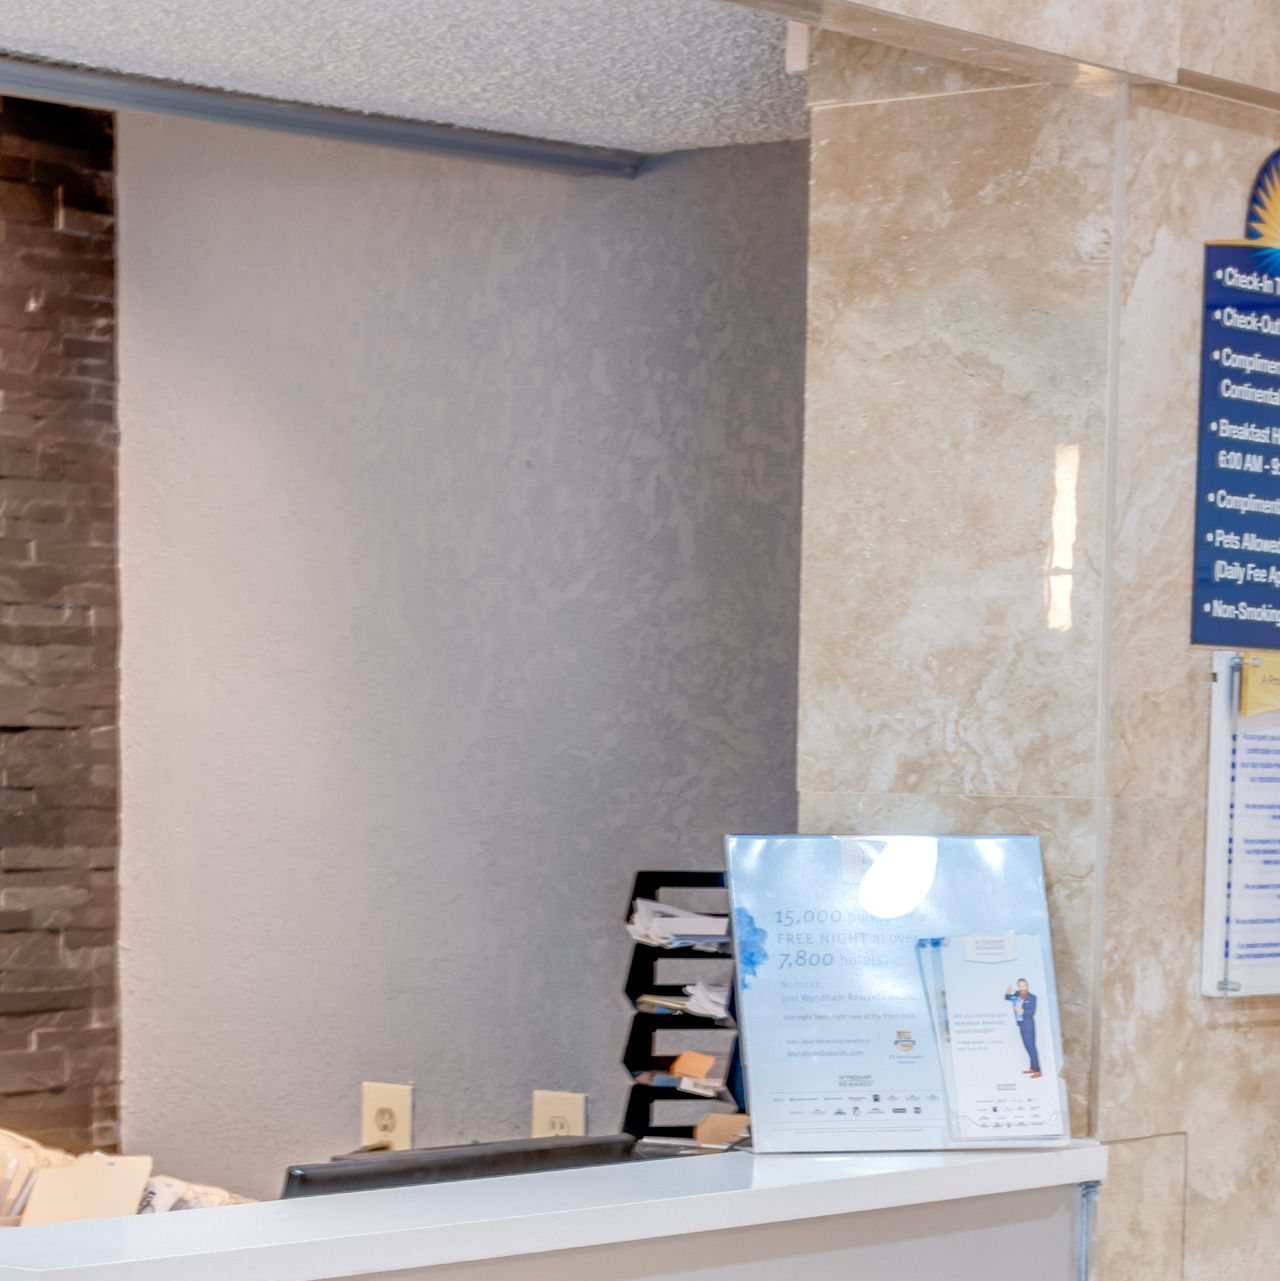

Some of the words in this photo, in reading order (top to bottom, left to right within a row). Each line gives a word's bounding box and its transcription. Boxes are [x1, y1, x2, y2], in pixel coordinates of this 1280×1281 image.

[1223, 266, 1274, 294] Check-In
[1218, 418, 1270, 444] Breakfast
[1218, 449, 1243, 470] 6:00
[1243, 453, 1264, 473] AM
[1214, 529, 1241, 550] Pets
[1214, 560, 1246, 585] (Daily
[1246, 563, 1268, 583] Fee
[775, 910, 842, 928] 15,000
[777, 933, 814, 945] FREE
[820, 933, 868, 945] NIGHT
[778, 950, 834, 970] 7,800
